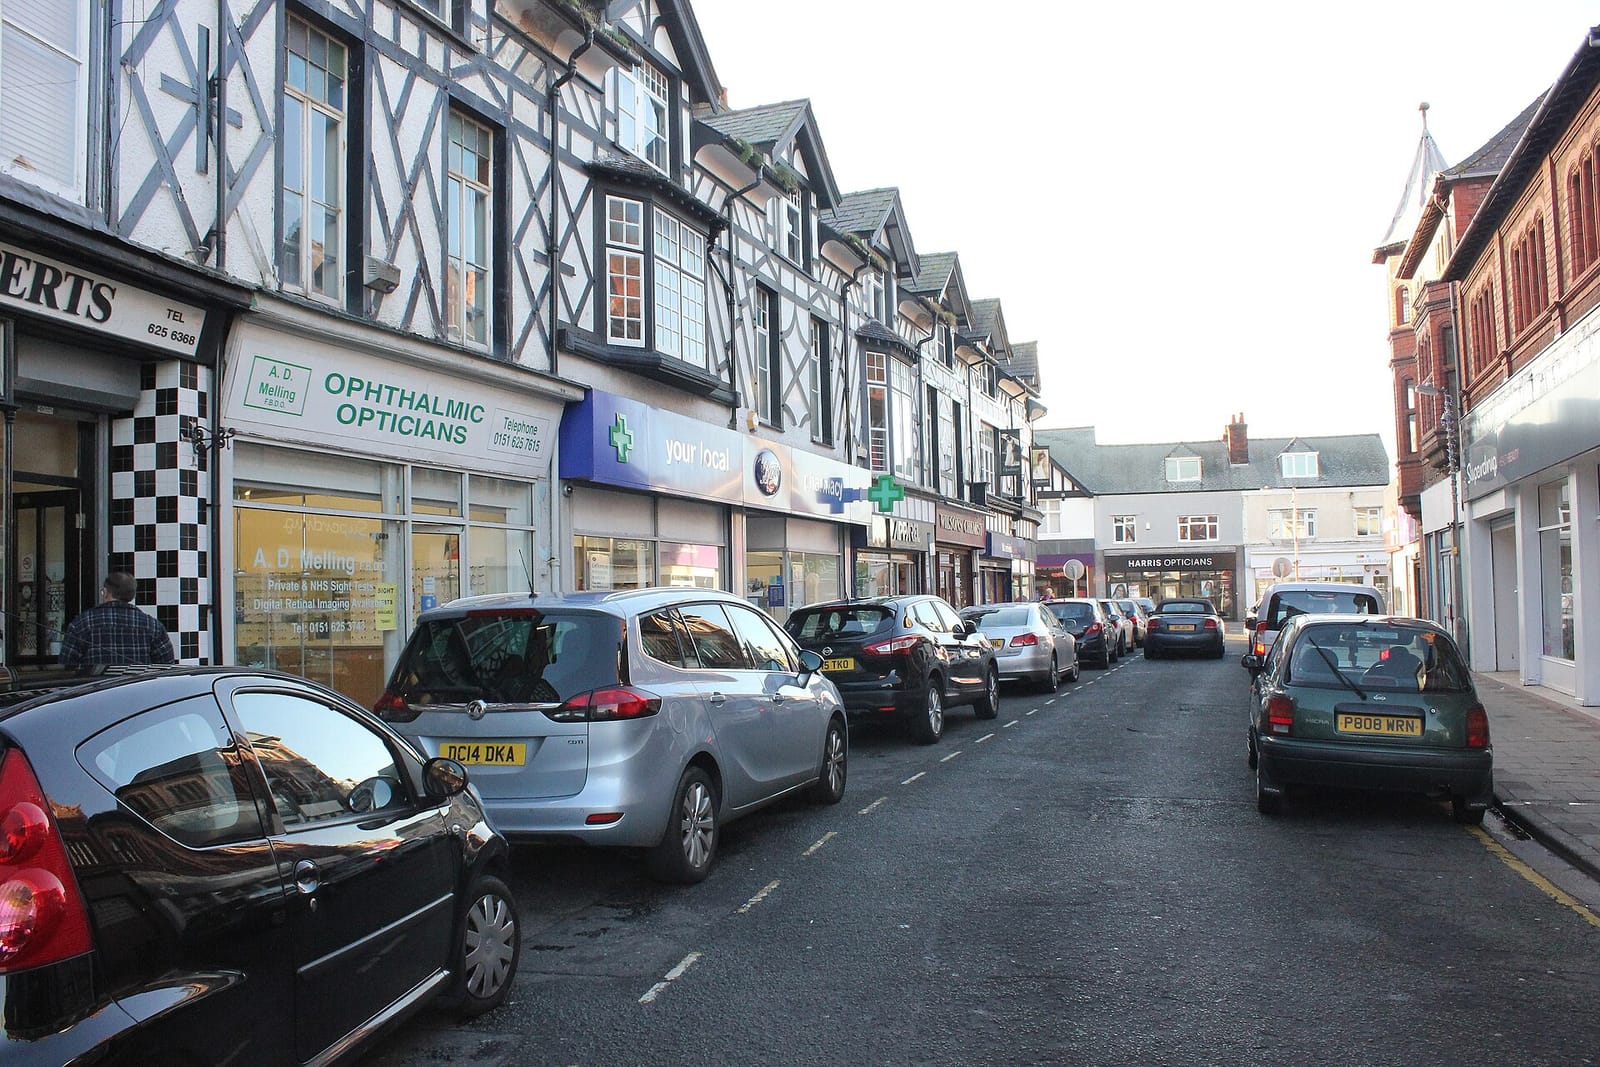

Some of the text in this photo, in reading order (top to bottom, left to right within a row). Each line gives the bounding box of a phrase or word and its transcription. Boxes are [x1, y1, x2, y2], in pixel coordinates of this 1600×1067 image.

[0, 251, 117, 323] ERTS
[166, 308, 185, 324] TEL
[147, 323, 196, 346] 625 6368
[258, 382, 296, 403] Melling
[324, 372, 485, 424] OPHTHALMIC
[336, 403, 468, 445] OPTICIANS
[504, 416, 538, 436] Telephone
[493, 432, 541, 452] 0151 625 7615
[665, 438, 730, 472] your local
[300, 549, 355, 575] Melling
[1164, 558, 1212, 567] OPTICIANS
[268, 581, 299, 592] Private
[302, 581, 308, 591] &
[311, 581, 329, 591] NHS
[331, 581, 352, 593] Sight
[254, 599, 282, 612] Digital
[286, 600, 315, 610] Retinal
[318, 600, 349, 611] Imaging
[293, 623, 307, 633] Tel:
[309, 622, 328, 632] 0151
[832, 660, 849, 670] TKO
[1344, 717, 1415, 732] P808 WRN
[448, 745, 515, 762] DC14 DKA
